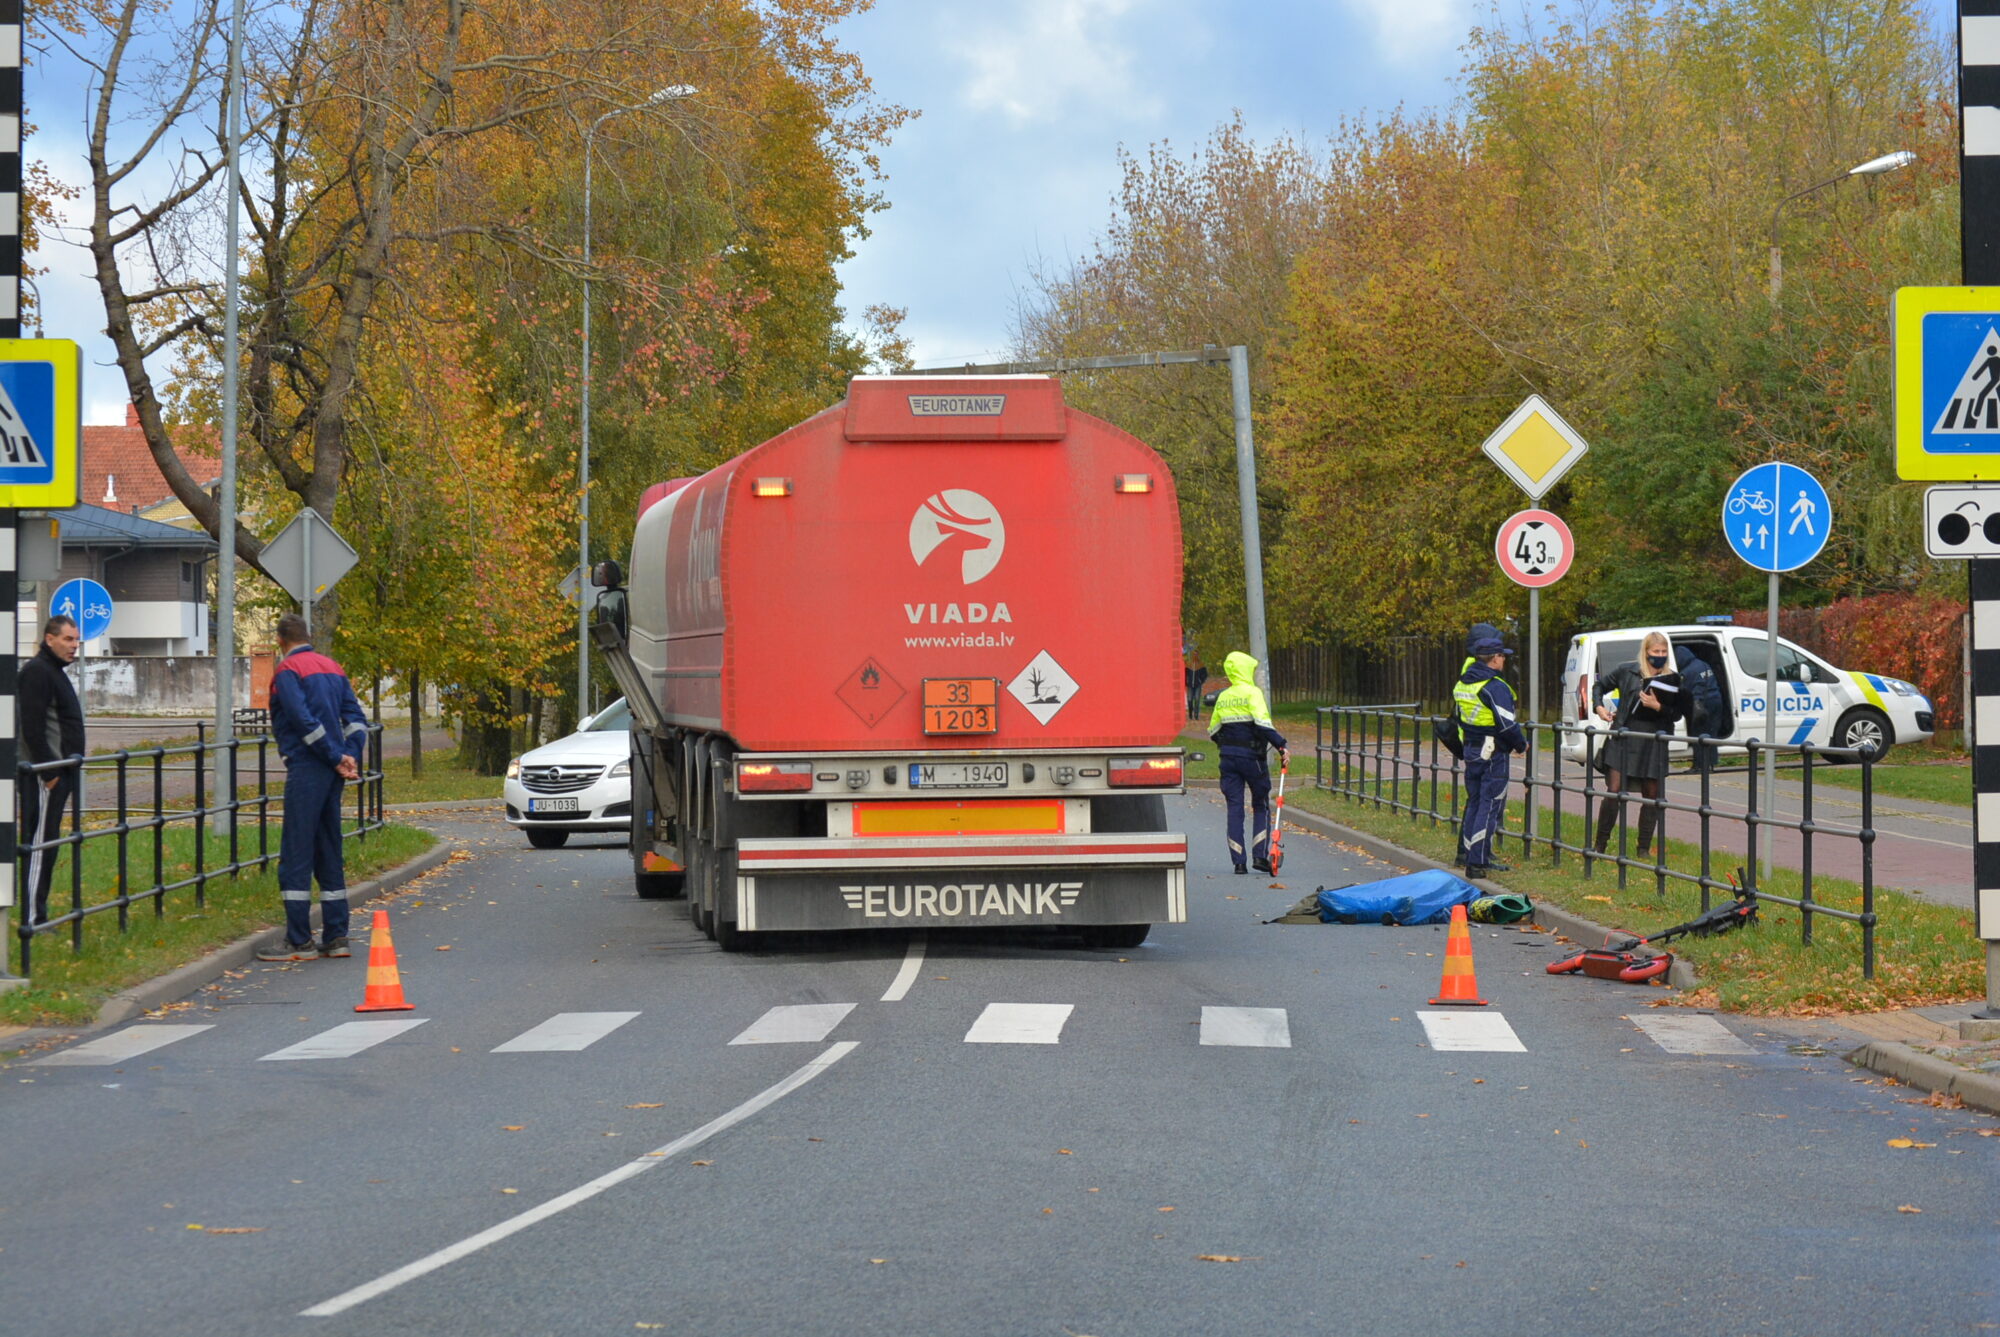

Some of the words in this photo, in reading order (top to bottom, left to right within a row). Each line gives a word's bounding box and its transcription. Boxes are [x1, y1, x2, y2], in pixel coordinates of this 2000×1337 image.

[922, 399, 991, 412] EUROTANK
[904, 603, 1012, 624] VIADA
[904, 632, 1015, 648] www.viada.lv
[947, 683, 970, 704] 33
[1740, 697, 1823, 712] POICIJA
[934, 708, 988, 730] 1203
[535, 800, 576, 811] JU-1039
[865, 883, 1061, 917] EUROTANK
